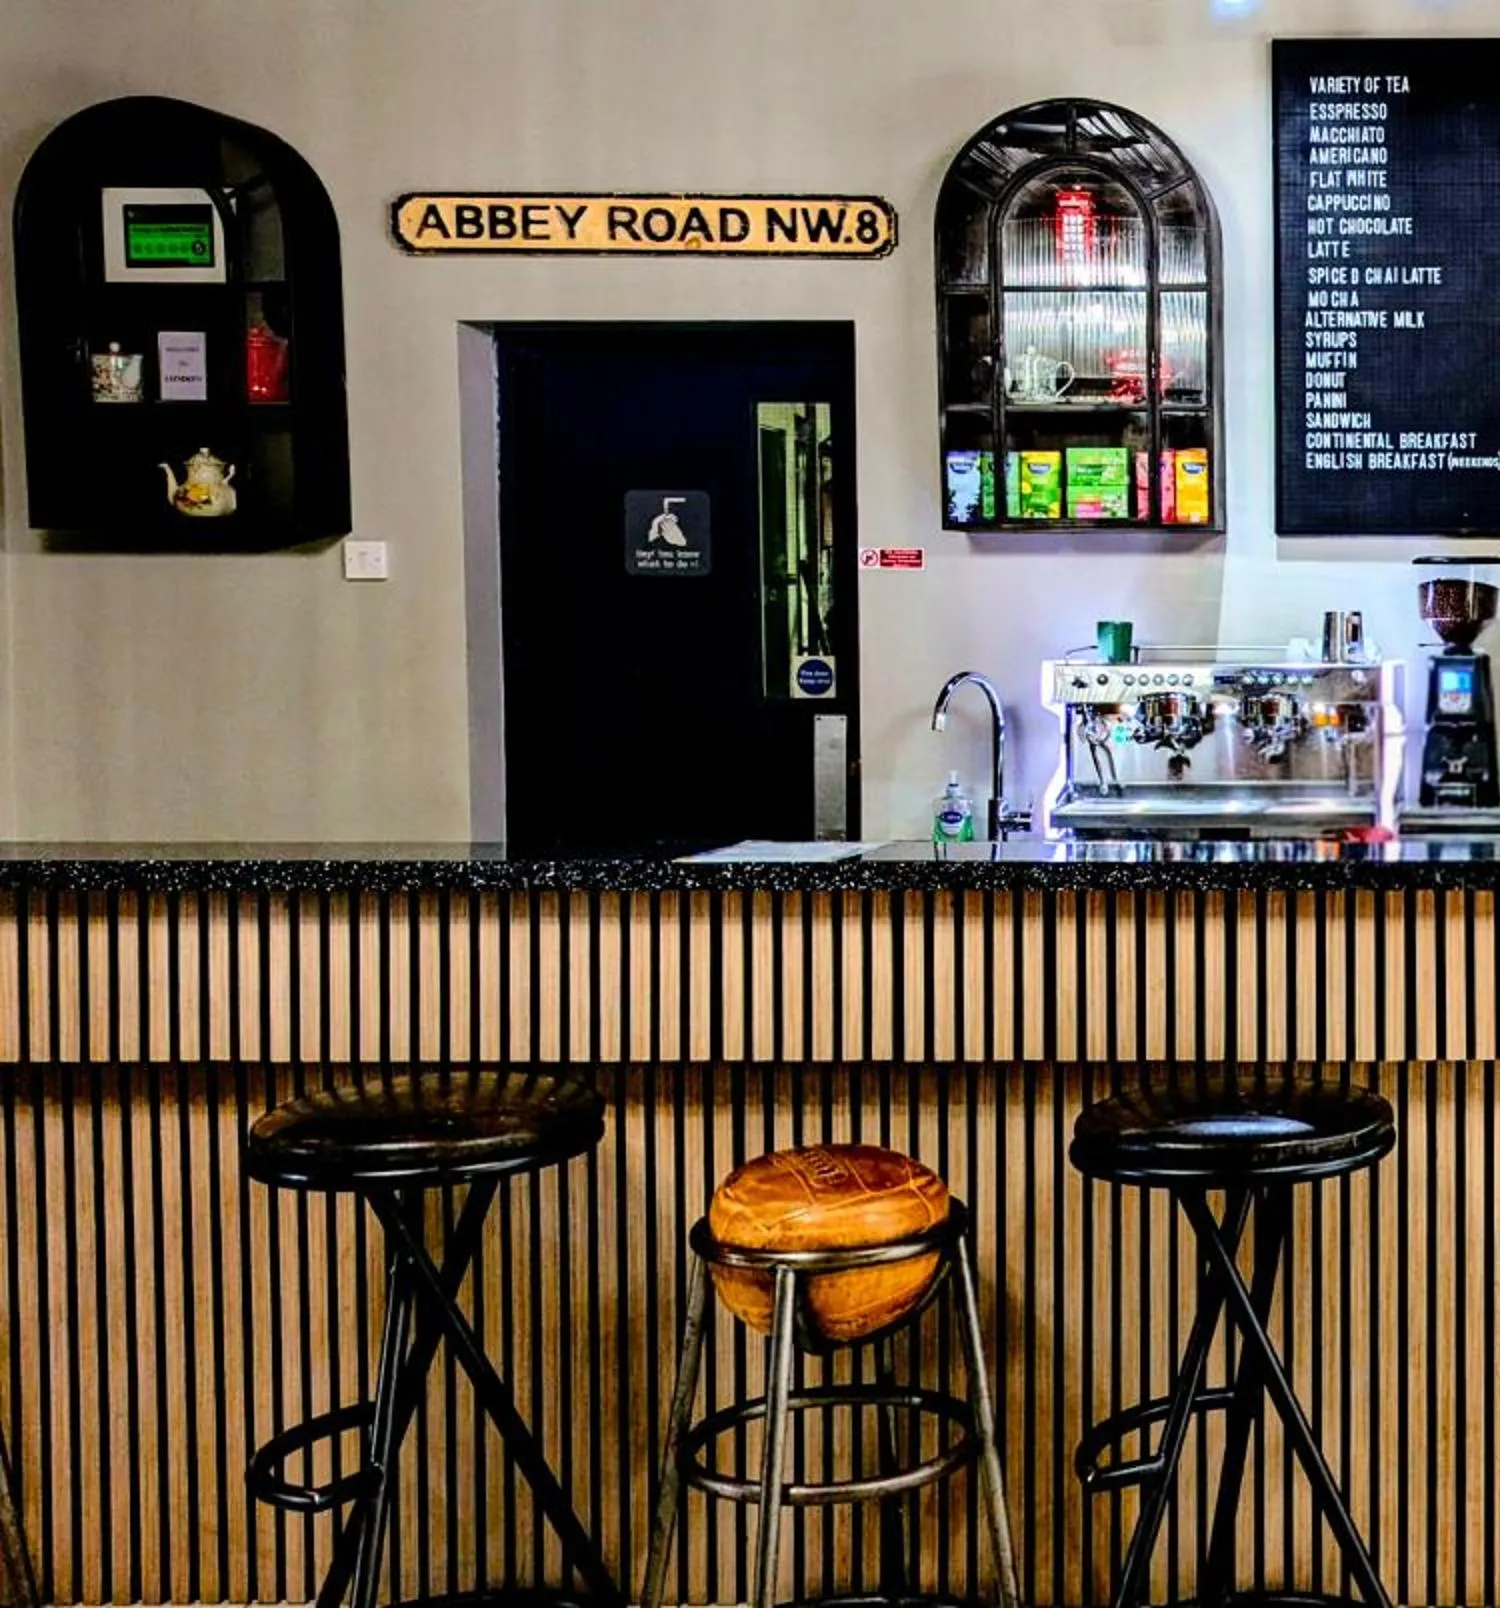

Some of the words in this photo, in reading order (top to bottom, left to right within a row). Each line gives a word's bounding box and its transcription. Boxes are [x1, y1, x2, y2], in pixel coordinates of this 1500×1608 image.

[1310, 76, 1360, 93] VARIETY
[1364, 77, 1380, 93] OF
[1386, 76, 1409, 93] TEA
[1309, 103, 1387, 121] ESSPRESSO
[1309, 125, 1384, 144] MACCHIATO
[1310, 147, 1387, 165] AMERICANO
[1309, 170, 1343, 189] FLAT
[1307, 193, 1390, 212] CAPPUCCINO
[416, 204, 588, 240] ABBEY
[608, 206, 750, 244] ROAD
[767, 208, 879, 245] NW.8
[1307, 217, 1334, 236] HOT
[1338, 217, 1412, 236] CHOCOLATE
[1307, 240, 1351, 259] LATTE
[1364, 267, 1398, 285] CHAI
[1402, 267, 1442, 284] LATTE
[1308, 290, 1359, 308] MOCHA
[1305, 311, 1388, 328] ALTERNATIVE
[1394, 311, 1424, 328] MILK
[1306, 331, 1357, 348] SYRUPS
[1306, 351, 1357, 368] MUFFIN
[1306, 372, 1346, 389] DONUT
[1306, 392, 1346, 408] PANINI
[1306, 412, 1371, 429] SANDWICH
[1306, 432, 1394, 449] CONTINENTAL
[1400, 432, 1476, 449] BREAKFAST
[1306, 452, 1362, 470] ENGLISH
[1368, 452, 1445, 470] BREAKFAST
